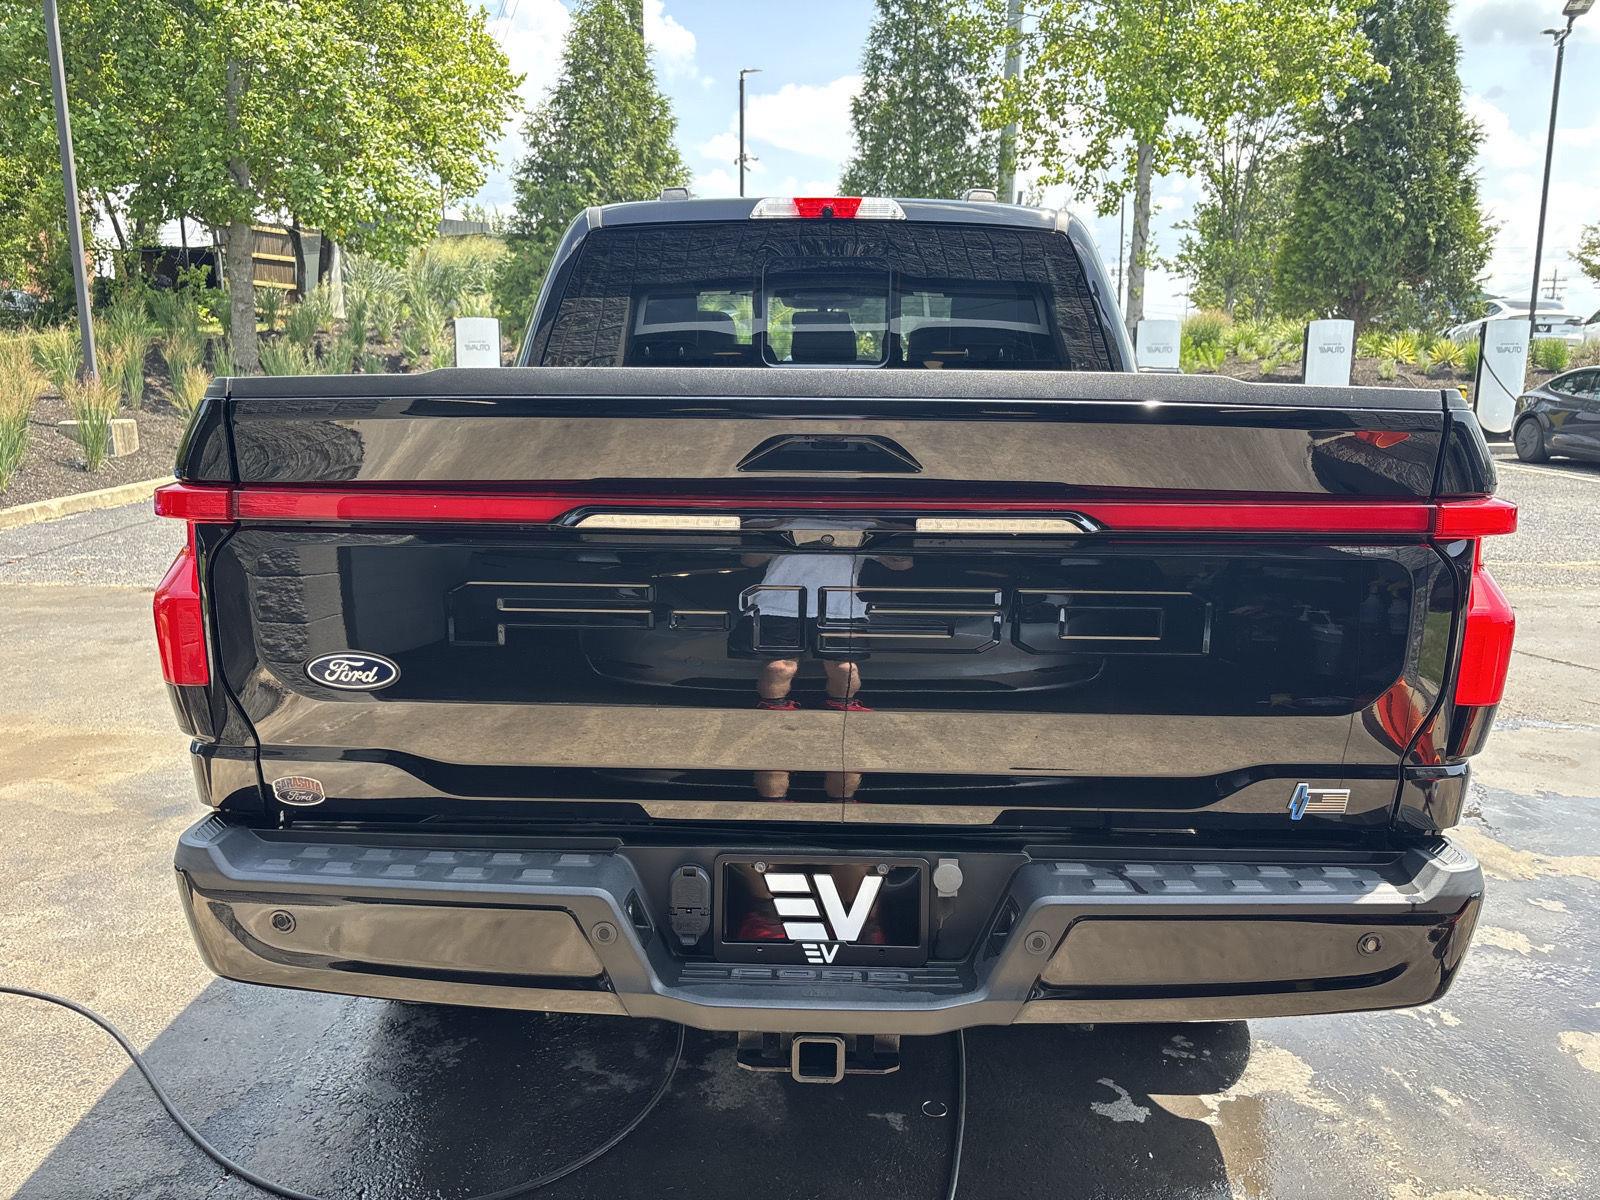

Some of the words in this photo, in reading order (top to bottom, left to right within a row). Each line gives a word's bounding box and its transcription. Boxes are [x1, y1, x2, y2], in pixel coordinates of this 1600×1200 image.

[324, 659, 378, 682] Ford
[275, 777, 322, 793] SARASOTA
[287, 791, 313, 800] Ford
[764, 874, 883, 941] EV
[802, 943, 840, 964] EV
